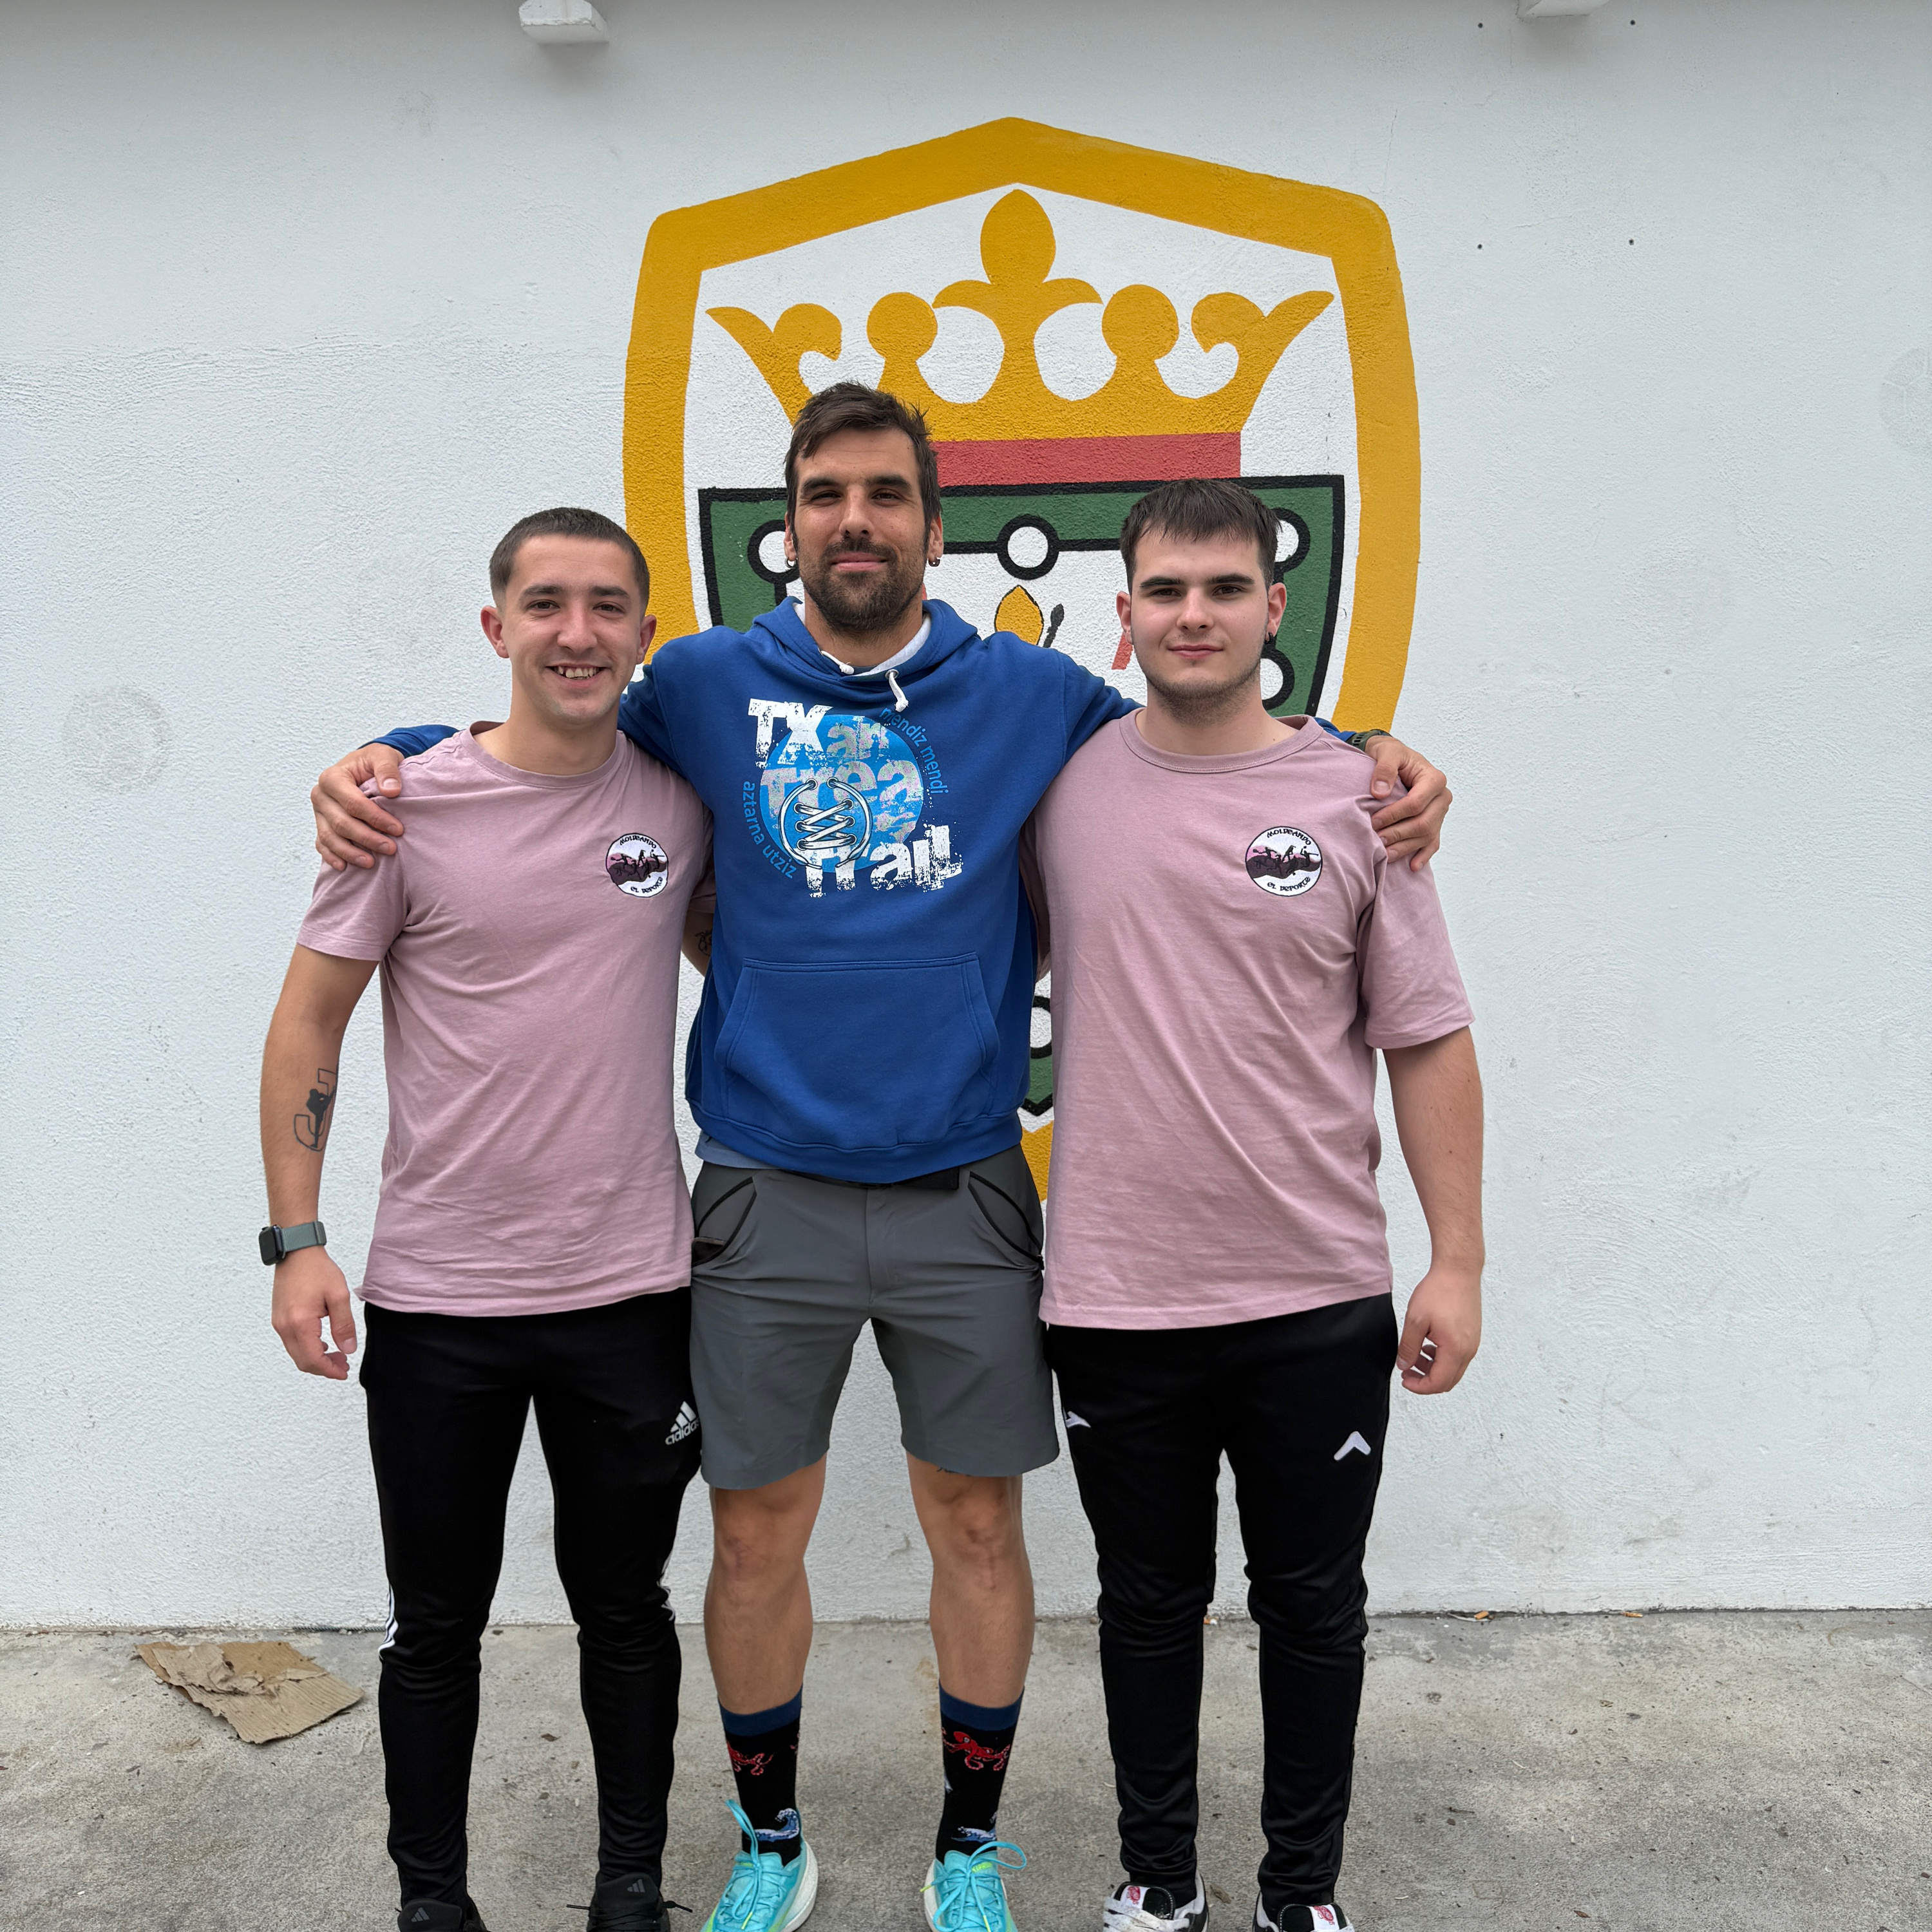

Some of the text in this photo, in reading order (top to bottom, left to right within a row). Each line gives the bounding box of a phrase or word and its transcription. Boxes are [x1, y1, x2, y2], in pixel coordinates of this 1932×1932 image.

[880, 707, 949, 795] mendiz mendi
[743, 781, 797, 878] aztarna utziz
